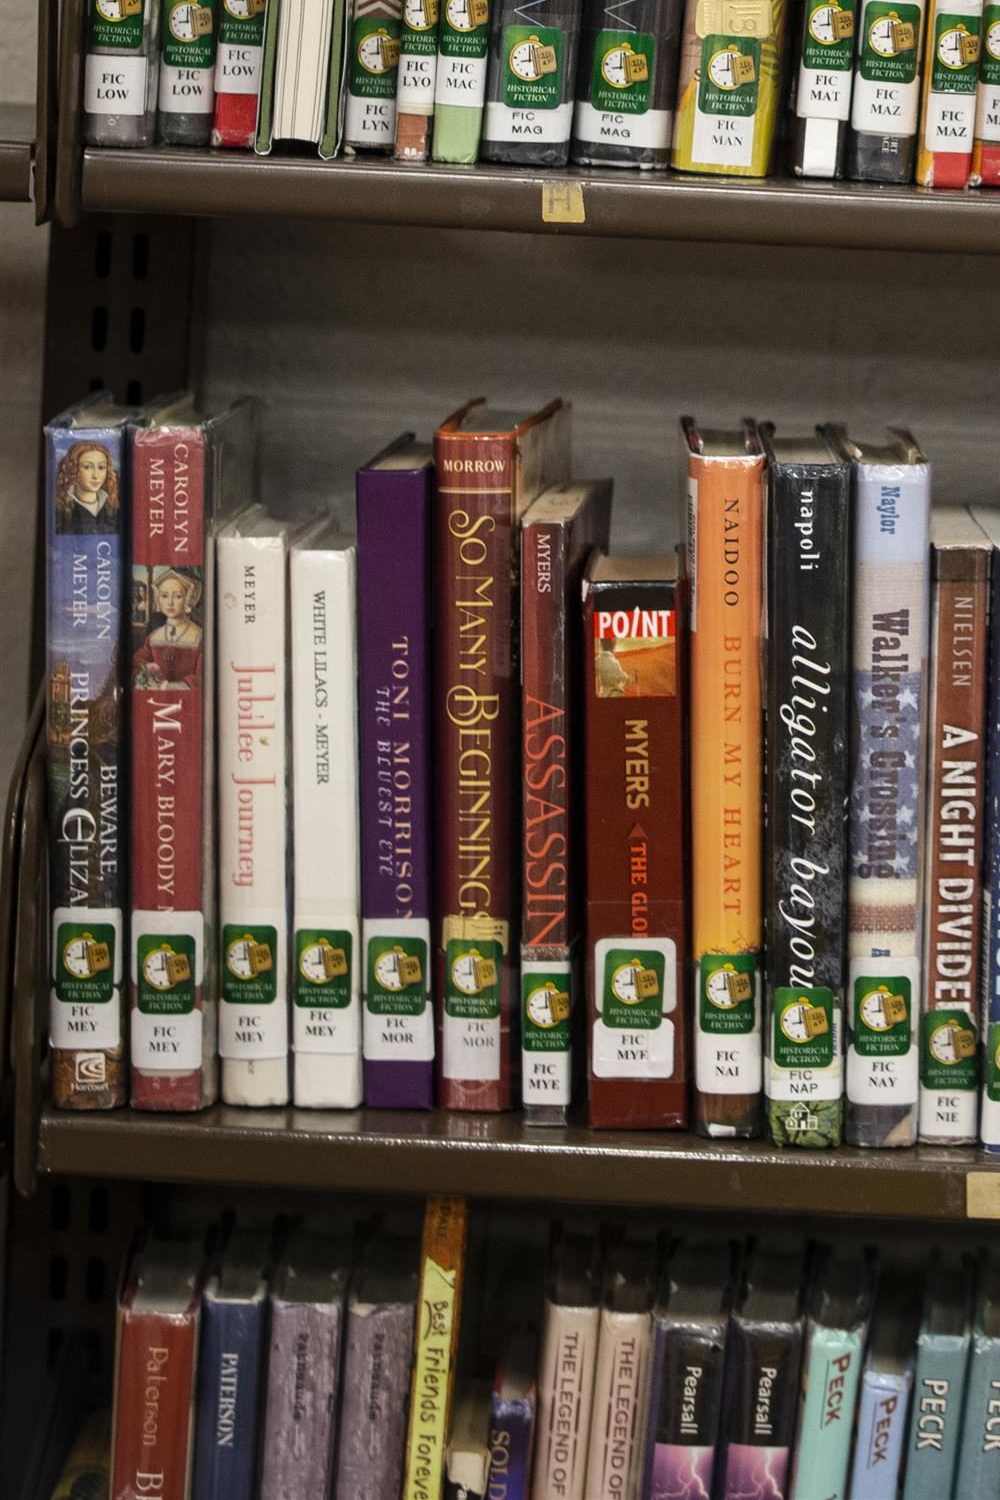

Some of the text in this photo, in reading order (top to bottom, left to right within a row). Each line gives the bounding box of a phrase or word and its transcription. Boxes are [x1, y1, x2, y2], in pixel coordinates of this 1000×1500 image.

[96, 89, 129, 100] LOW
[102, 73, 125, 86] FIC
[149, 457, 165, 539] MEYER
[174, 444, 189, 553] CAROLYN
[443, 458, 506, 473] MORROW
[723, 497, 740, 606] NAIDOO
[794, 489, 820, 572] napoli
[879, 486, 901, 536] Naylor
[598, 606, 672, 639] POINT
[69, 672, 89, 799] PRINCESS
[623, 718, 649, 809] MYERS
[781, 625, 832, 838] alligator
[858, 609, 909, 880] Walker's Crossing
[230, 662, 278, 888] Jubilee Journey
[721, 636, 742, 916] BURN MY HEART
[524, 694, 568, 947] ASSASSIN
[715, 1064, 740, 1077] NAI
[716, 1050, 740, 1061] FIC
[142, 1346, 168, 1446] Paterson
[216, 1352, 240, 1447] PATERSON
[681, 1366, 701, 1435] Pearsall
[826, 1352, 851, 1426] PECK
[916, 1379, 947, 1451] PECK
